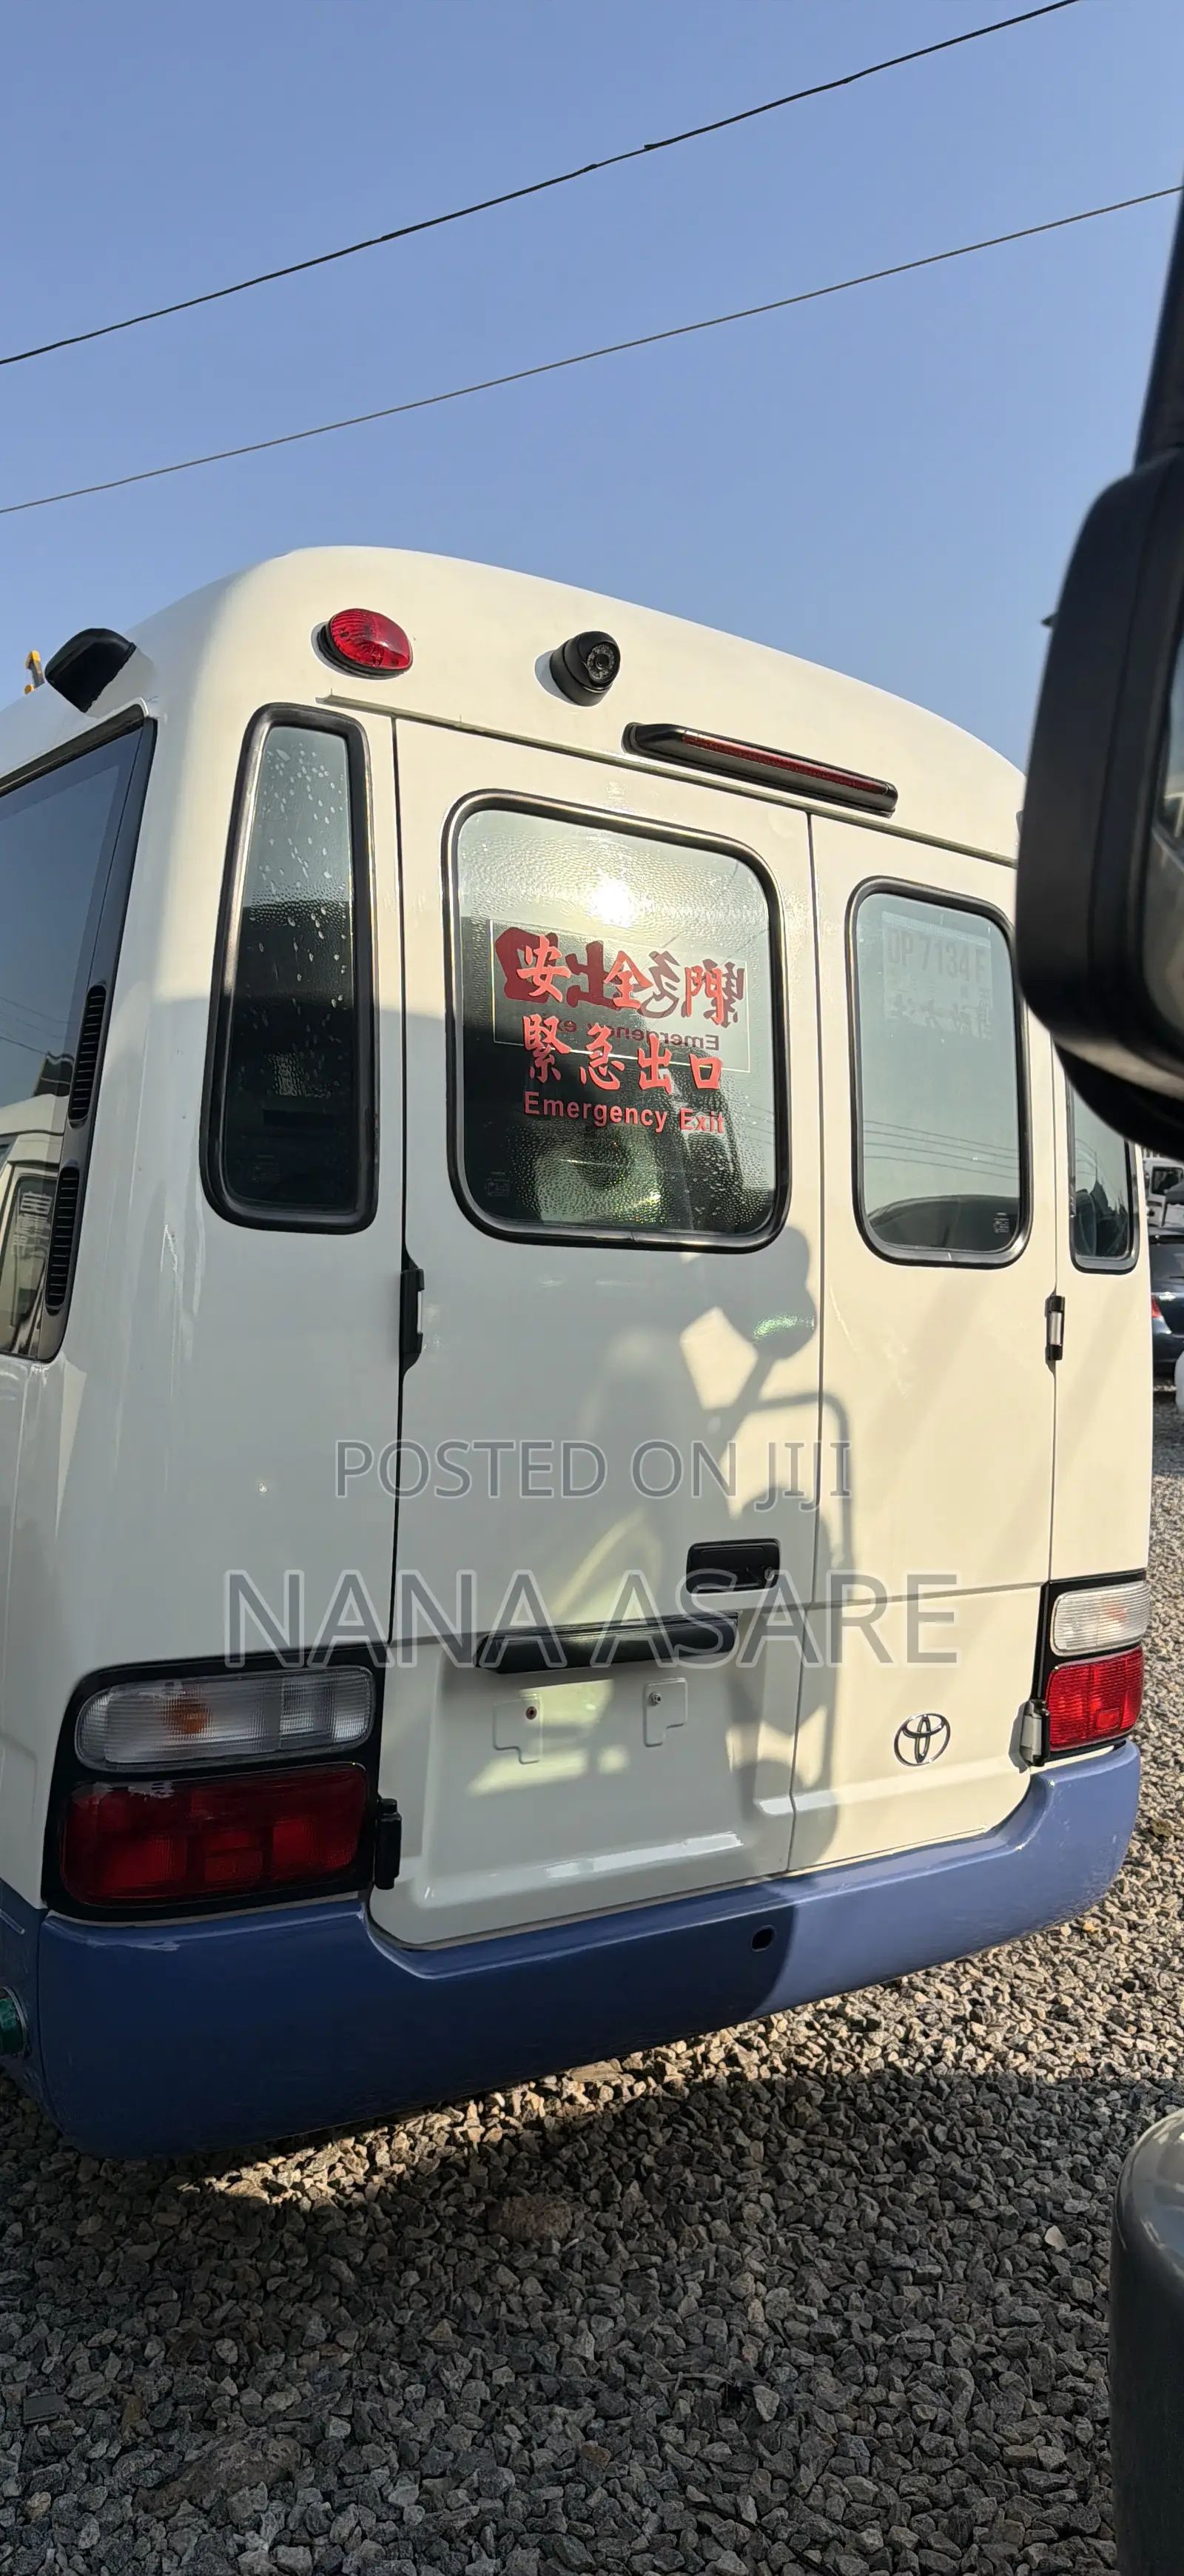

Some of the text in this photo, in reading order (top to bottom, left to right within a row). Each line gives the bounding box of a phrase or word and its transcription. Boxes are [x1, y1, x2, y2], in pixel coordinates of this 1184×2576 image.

[517, 935, 724, 1025] 安全門
[522, 1013, 724, 1094] 緊急出口
[524, 1092, 725, 1133] Emergency Exit
